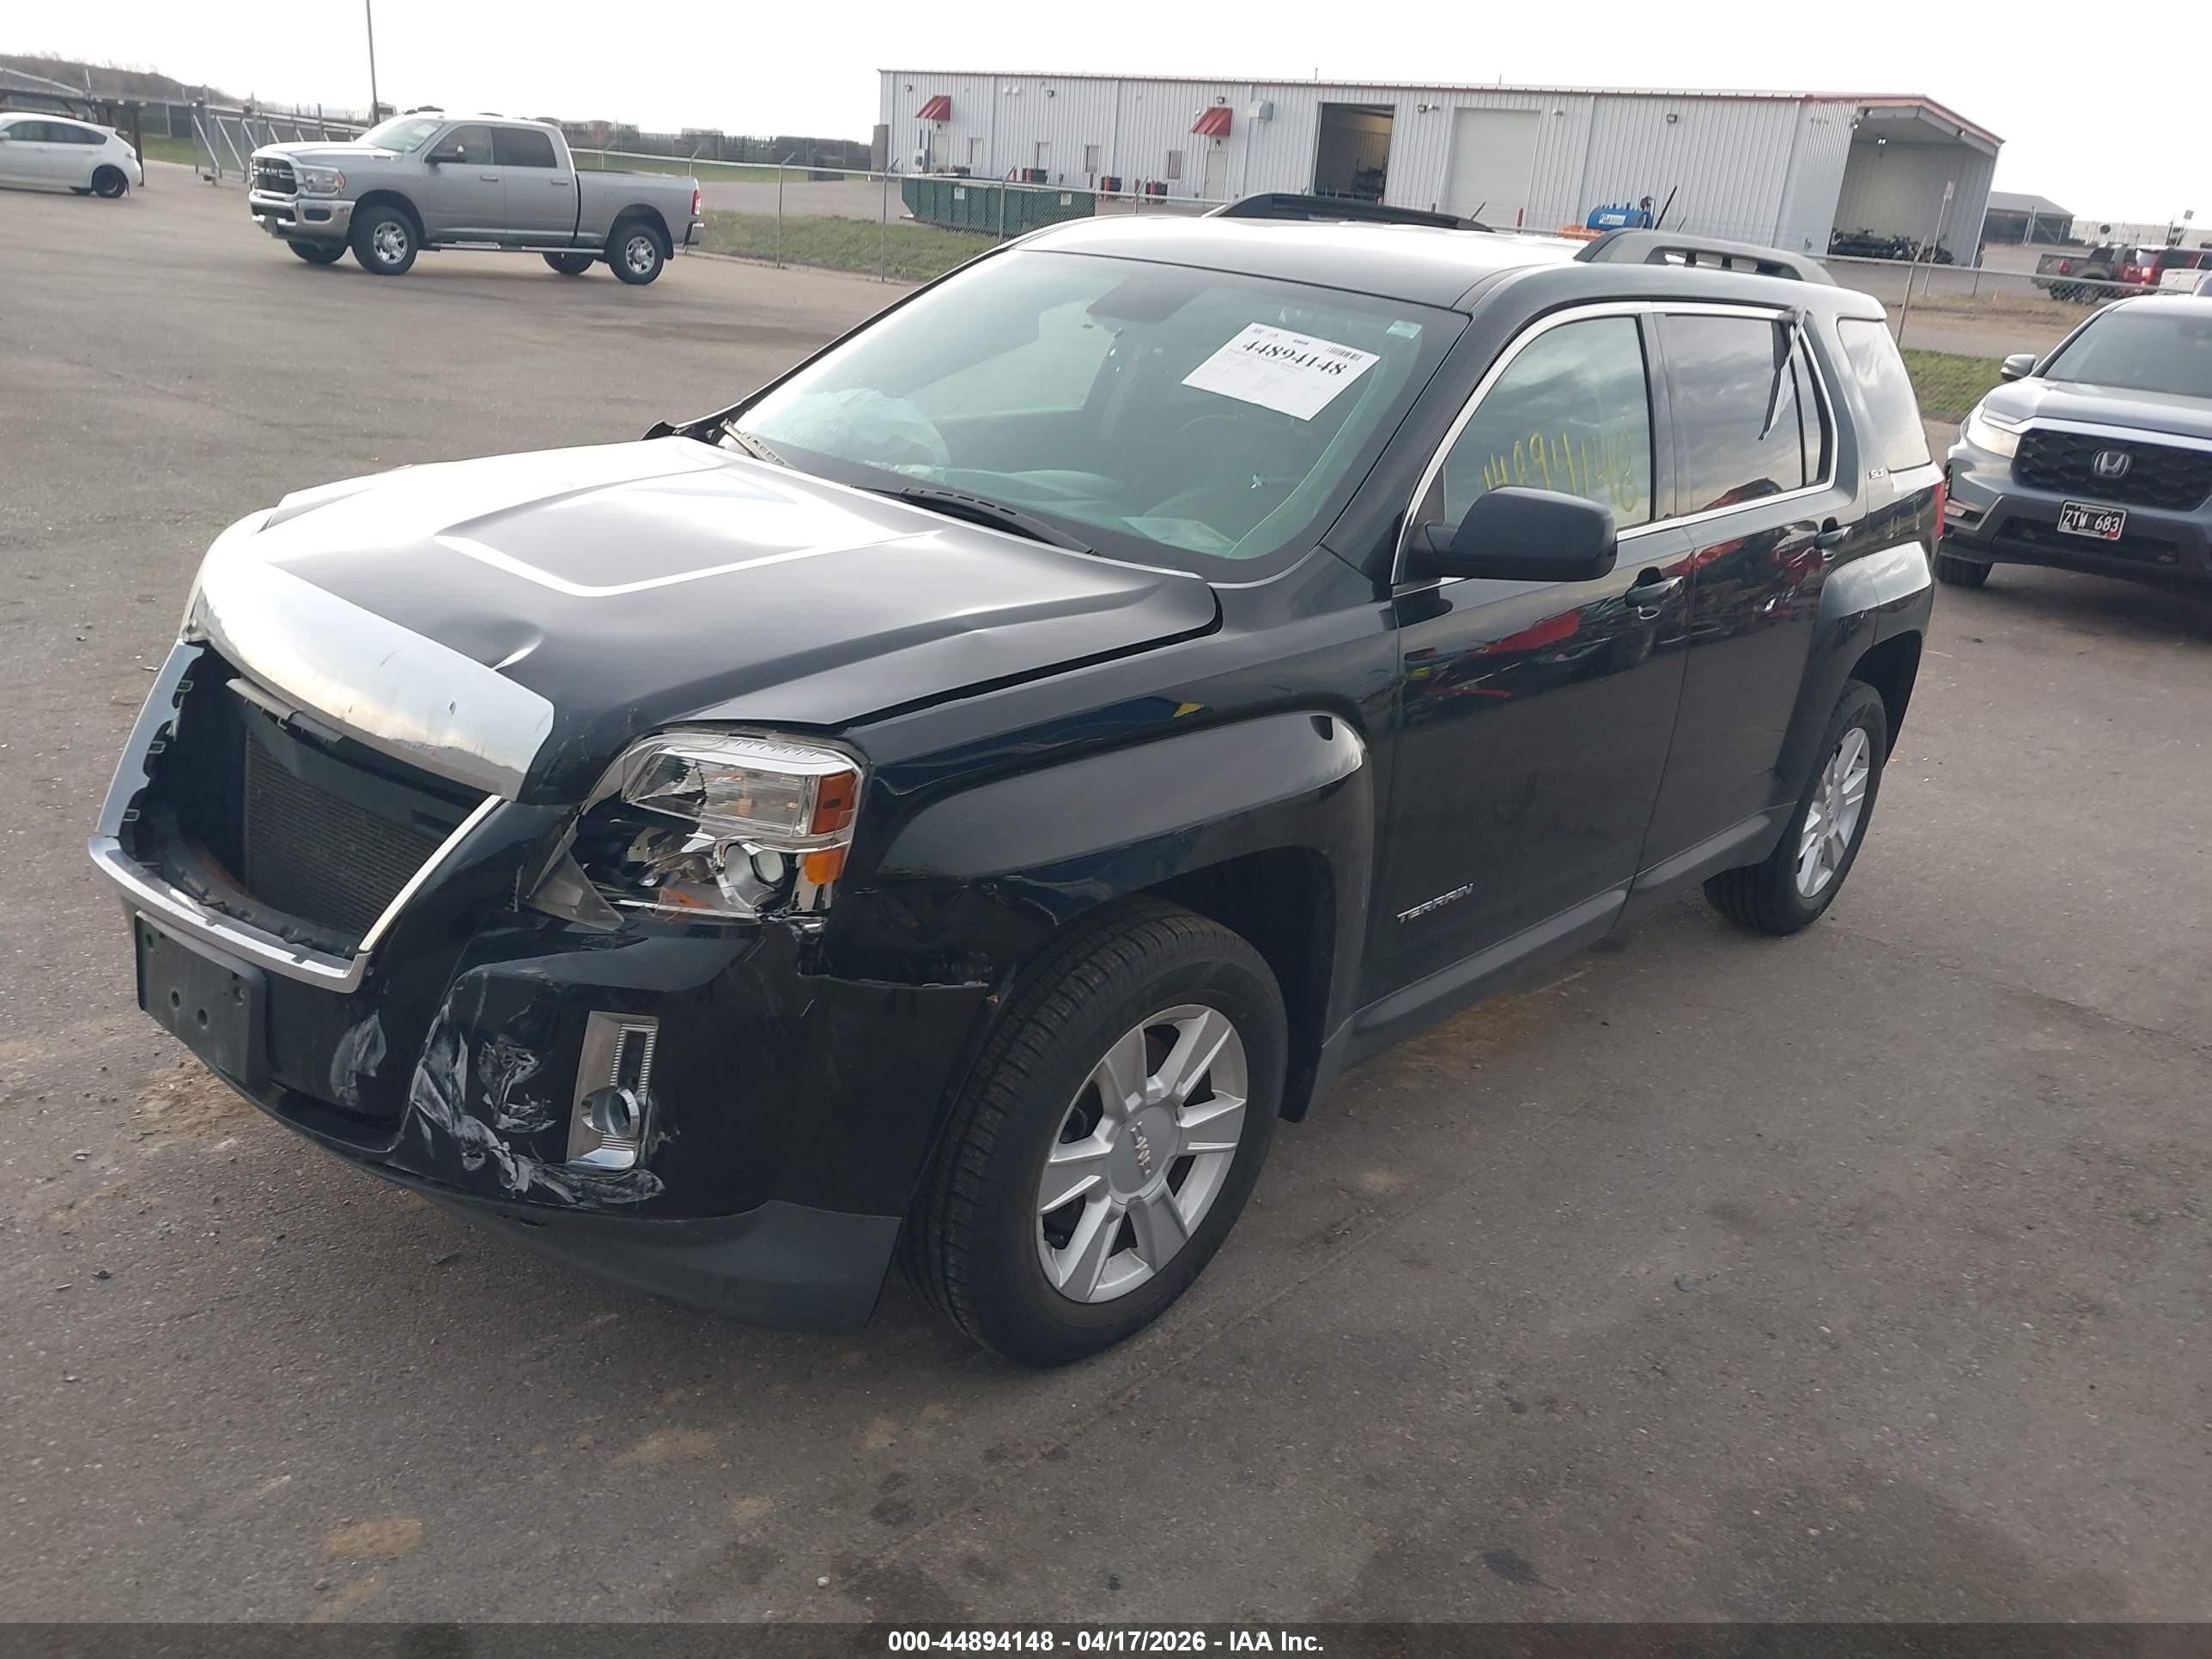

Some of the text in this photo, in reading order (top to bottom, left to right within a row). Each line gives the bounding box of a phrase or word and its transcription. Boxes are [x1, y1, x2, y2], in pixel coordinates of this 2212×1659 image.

[1243, 339, 1347, 376] 44894148
[2063, 510, 2089, 528] ZTW
[2094, 515, 2120, 532] 683
